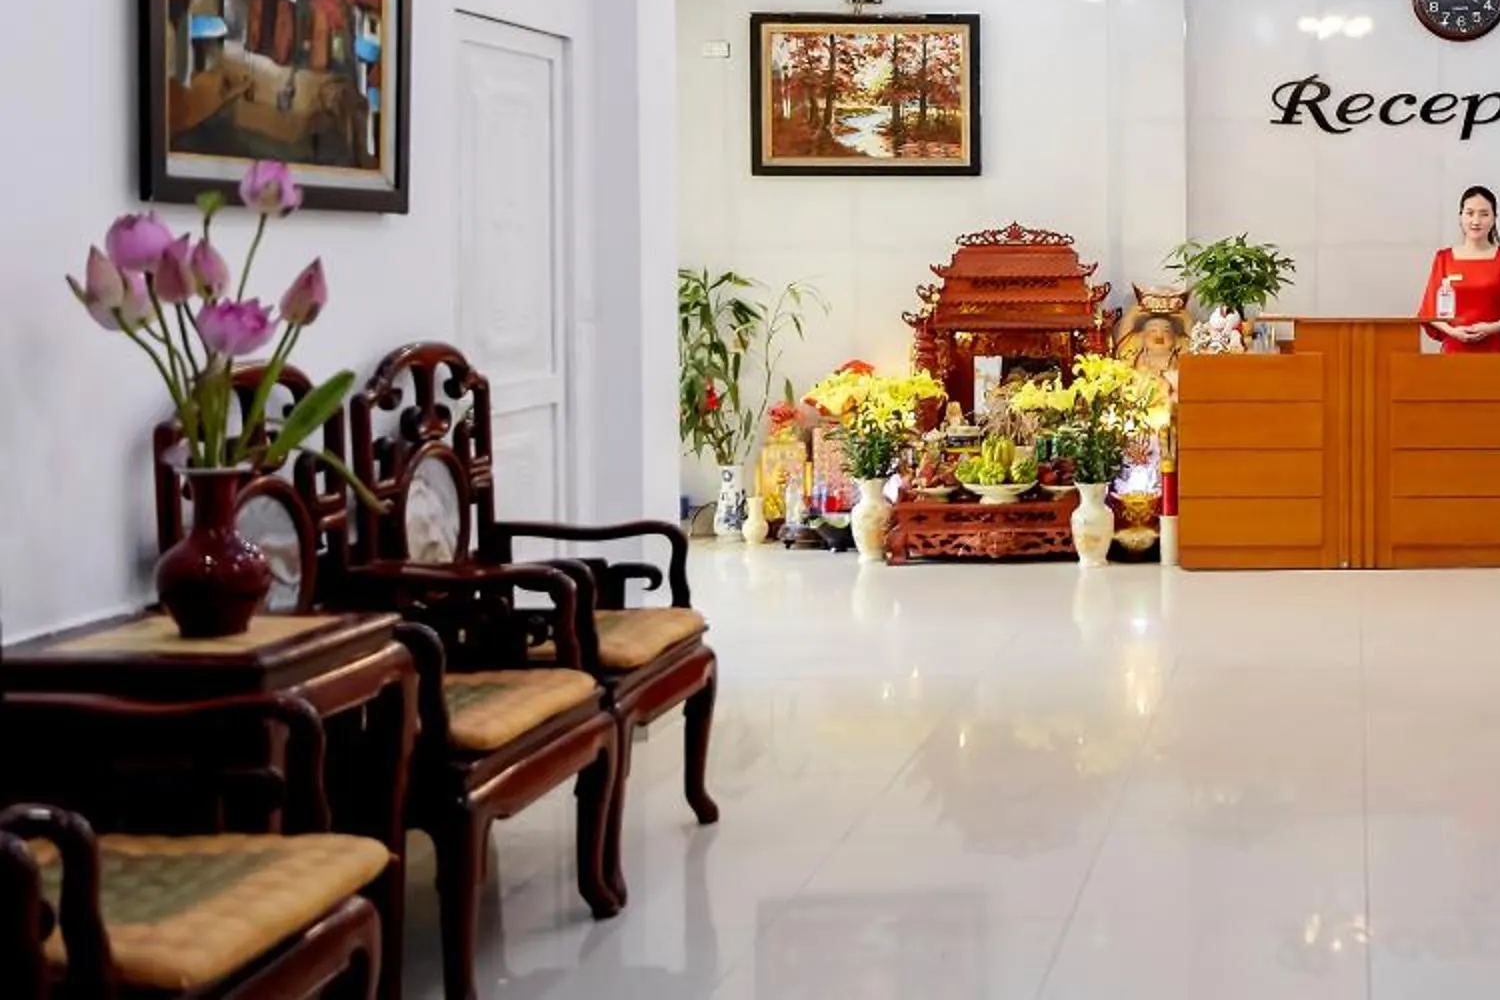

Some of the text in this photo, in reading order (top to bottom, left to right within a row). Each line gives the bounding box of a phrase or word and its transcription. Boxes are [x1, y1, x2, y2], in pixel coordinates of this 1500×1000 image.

[1429, 1, 1439, 12] 8
[1483, 0, 1493, 11] 4
[1441, 11, 1451, 25] 7
[1456, 15, 1467, 27] 6
[1472, 11, 1481, 23] 5
